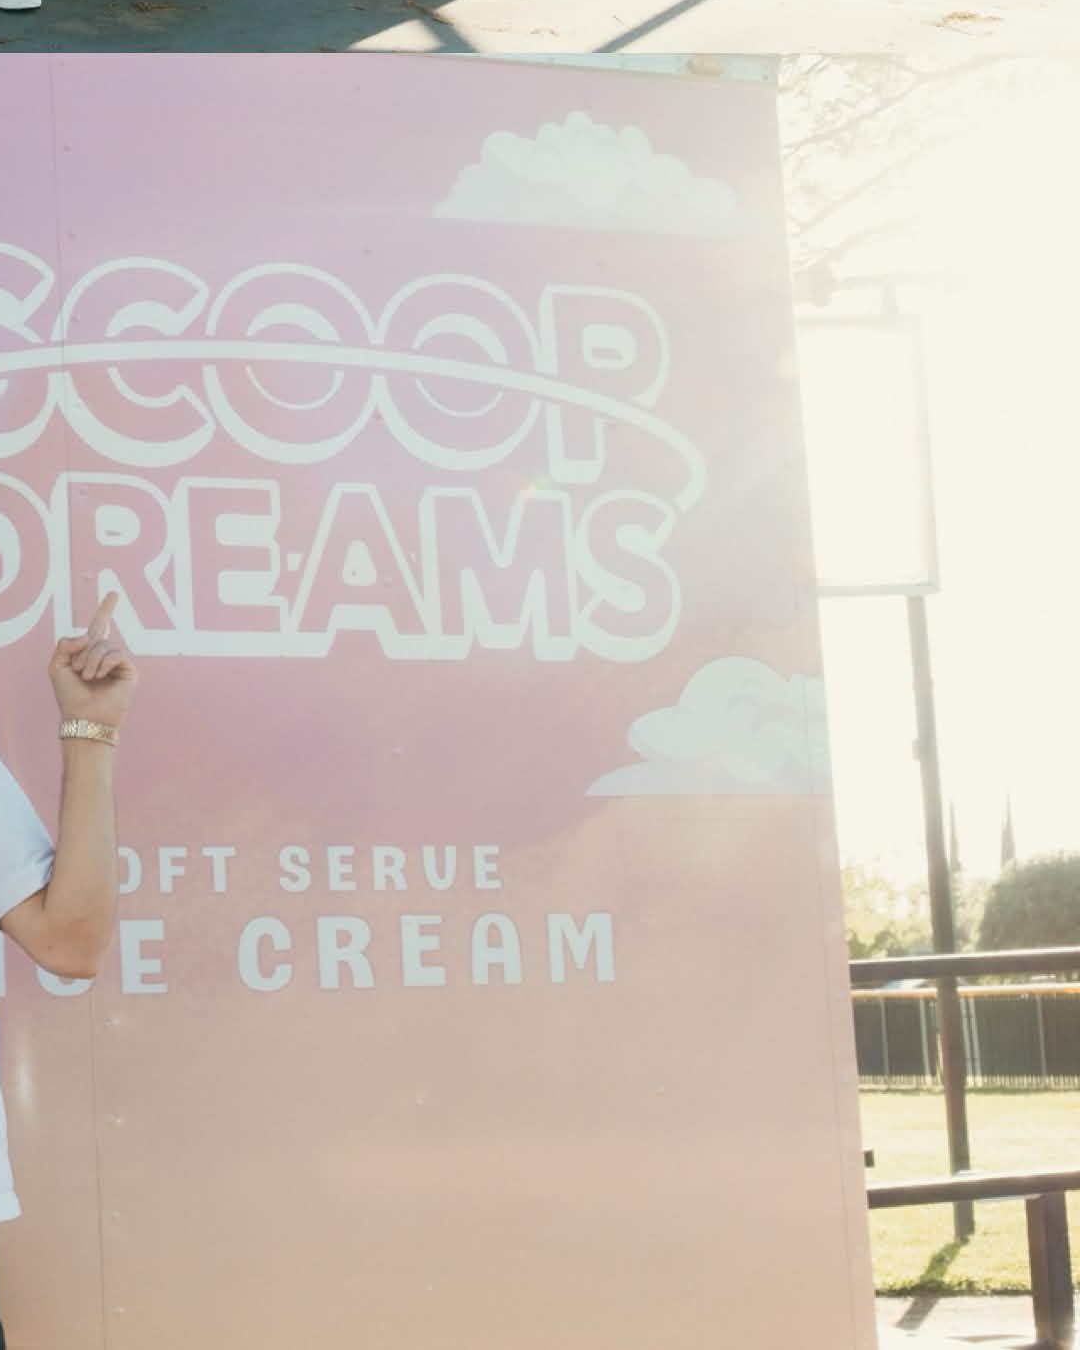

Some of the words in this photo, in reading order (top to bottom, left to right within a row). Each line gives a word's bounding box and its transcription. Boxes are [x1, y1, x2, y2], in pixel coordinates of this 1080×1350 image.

[118, 845, 235, 894] OFT
[278, 843, 505, 892] SERVE
[237, 911, 615, 990] CREAM
